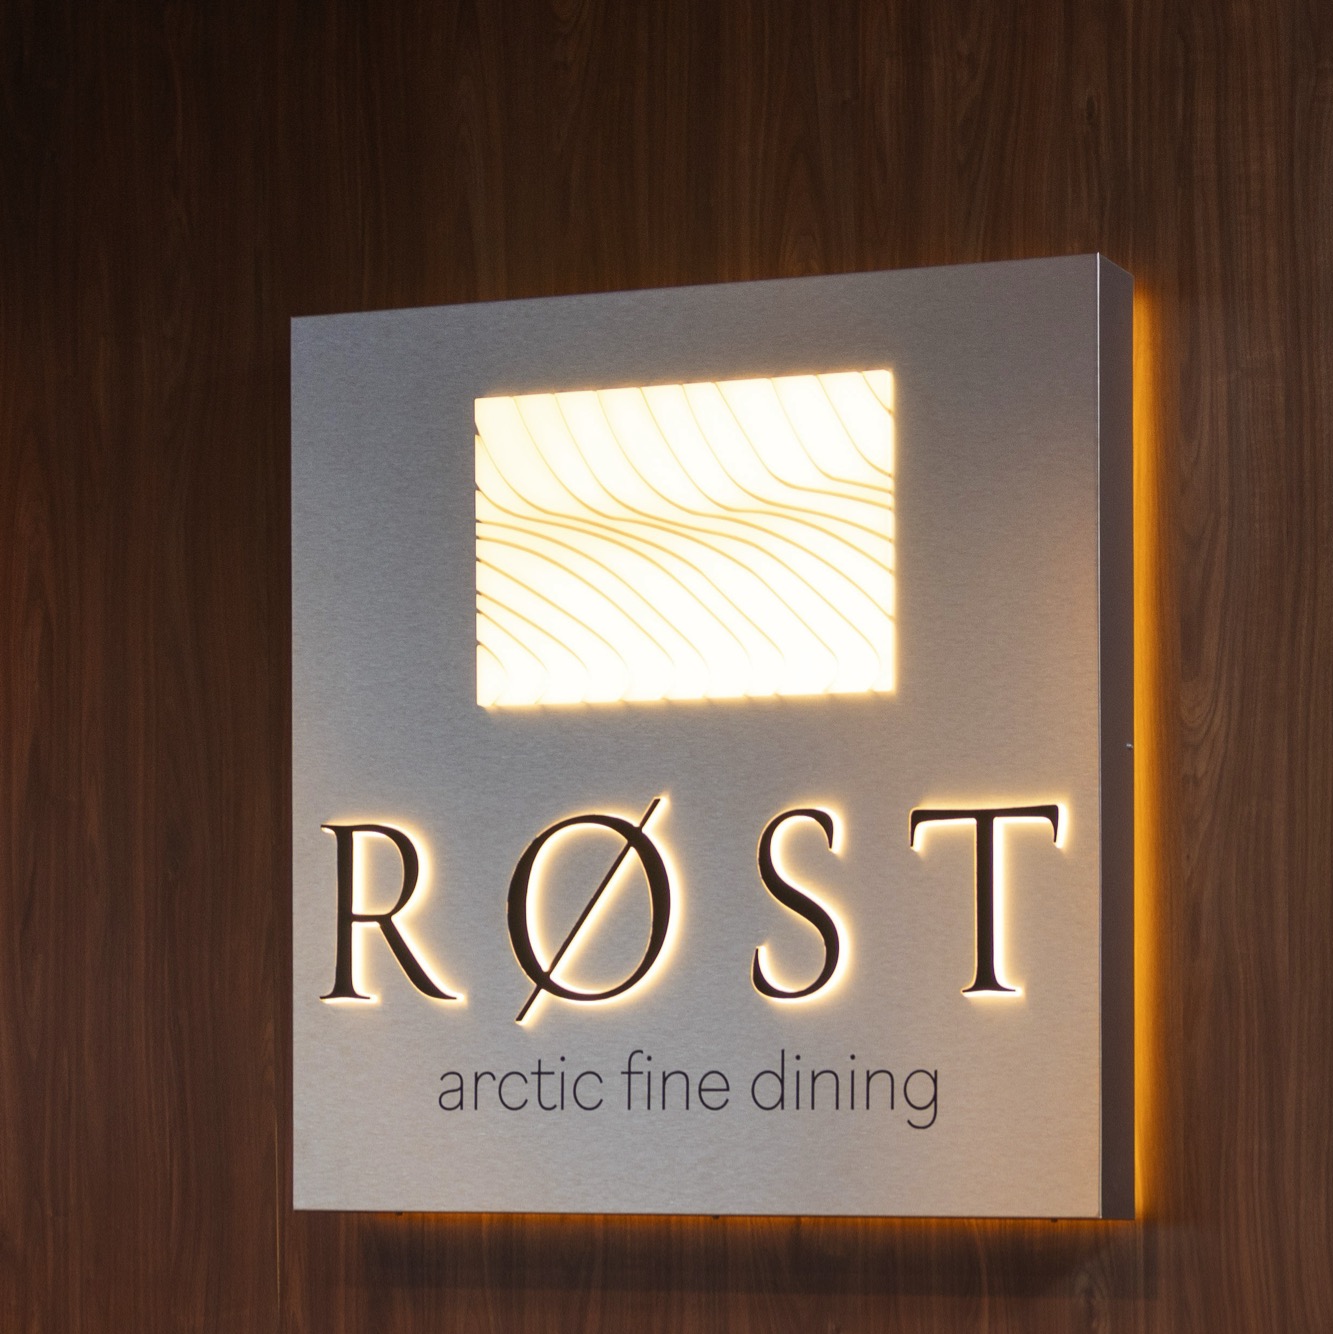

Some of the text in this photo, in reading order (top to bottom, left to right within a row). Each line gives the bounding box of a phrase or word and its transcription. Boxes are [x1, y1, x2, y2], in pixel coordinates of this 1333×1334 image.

[319, 796, 1062, 1024] RØST
[437, 1048, 940, 1130] arctic fine dining
